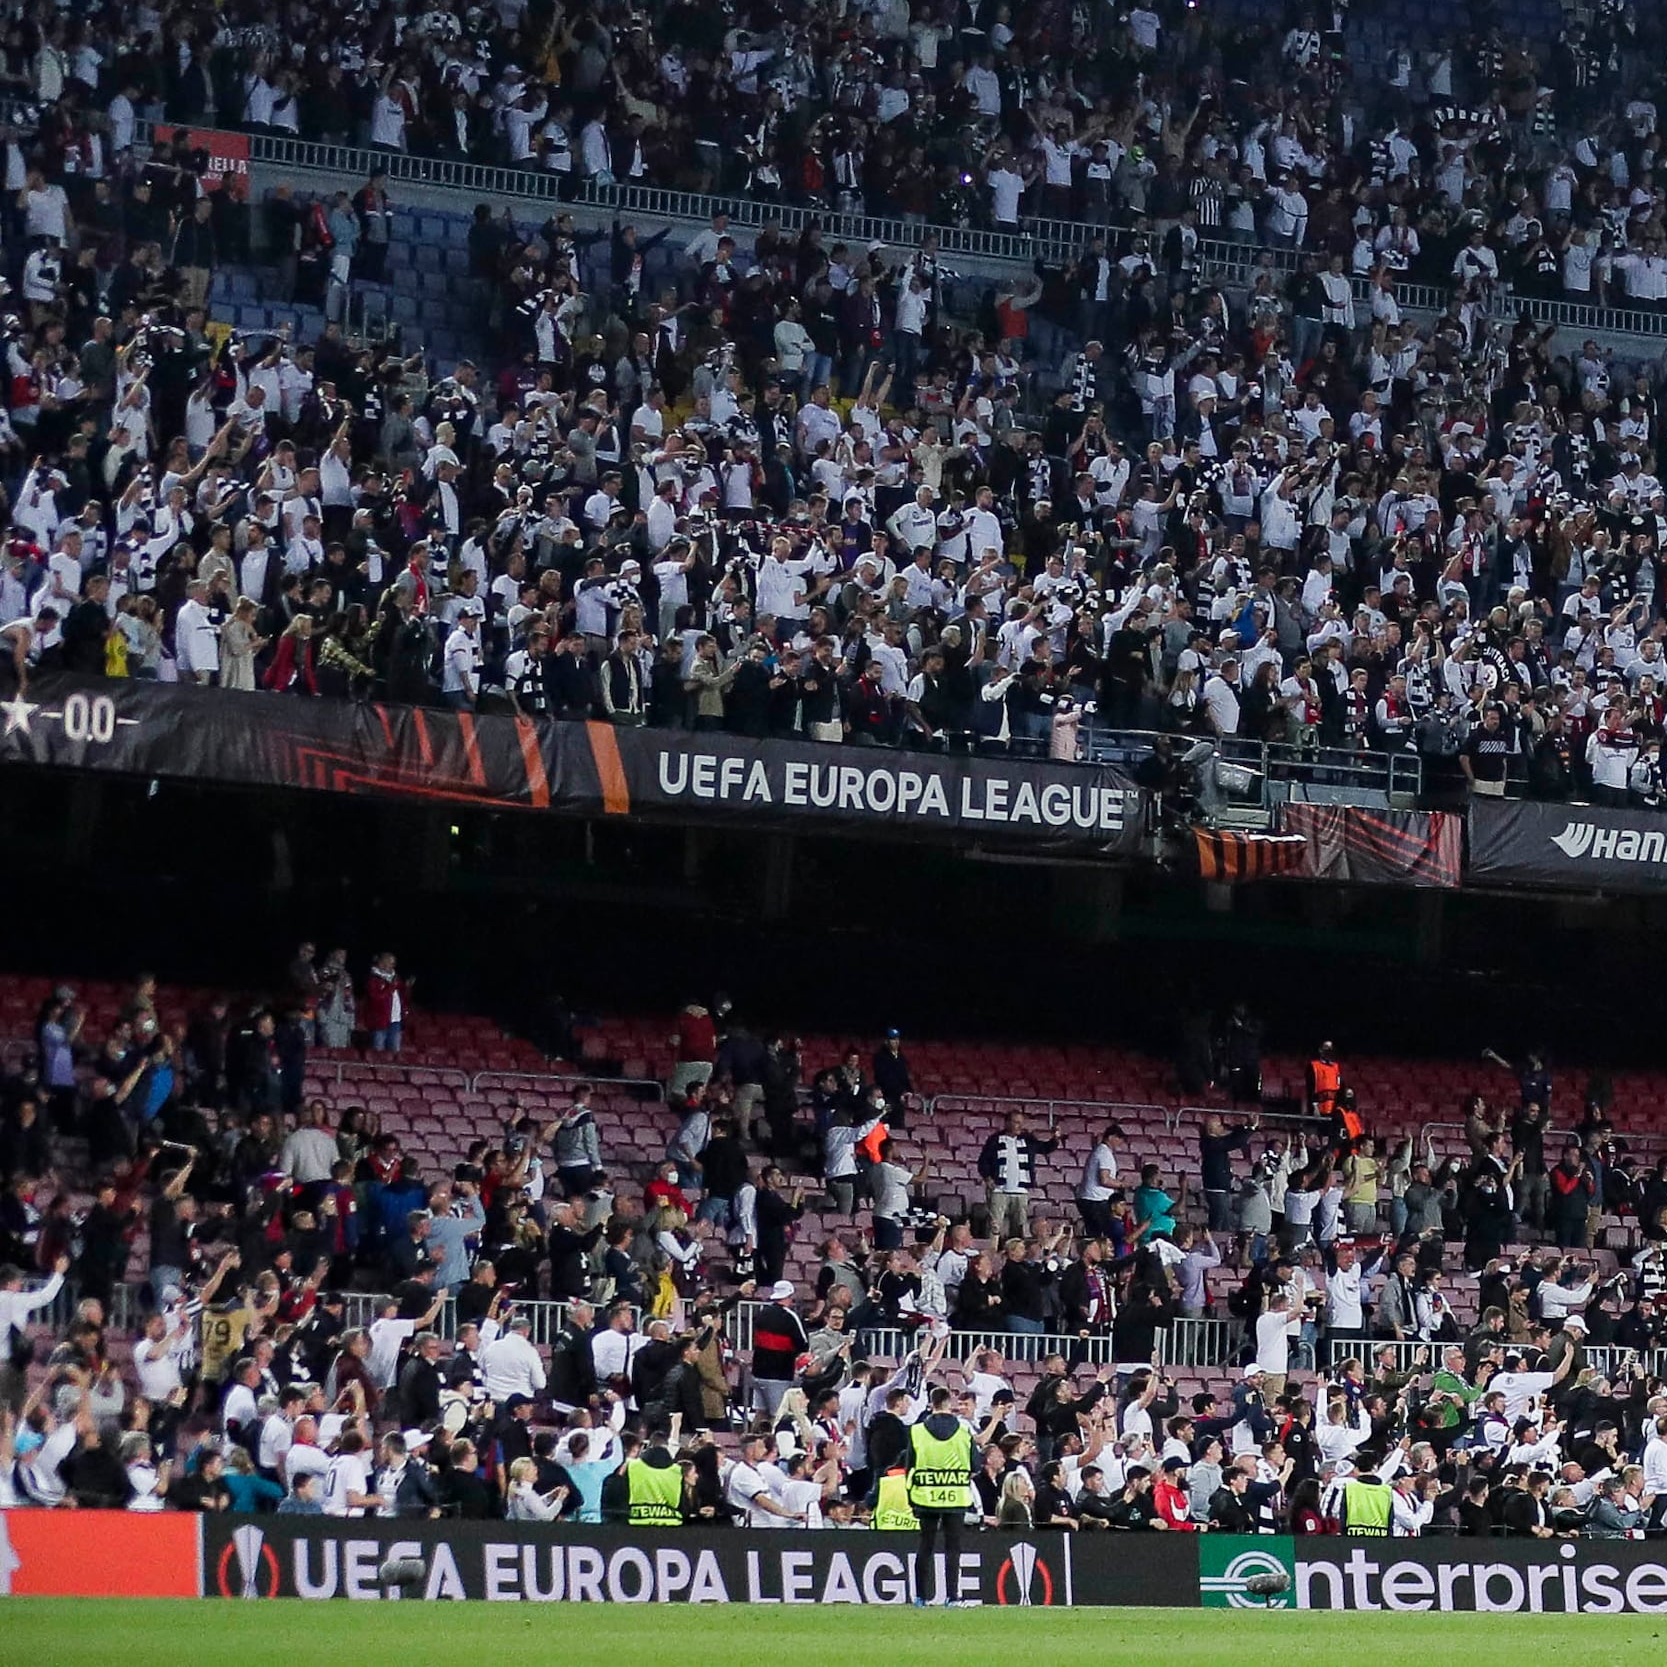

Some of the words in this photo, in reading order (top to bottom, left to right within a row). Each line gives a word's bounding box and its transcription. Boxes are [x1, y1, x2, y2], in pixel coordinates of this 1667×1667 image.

[658, 749, 772, 803] UEFA
[784, 763, 949, 817] EUROPA
[929, 1490, 957, 1502] 146
[484, 1542, 731, 1603] EUROPA
[746, 1548, 984, 1606] LEAGUE
